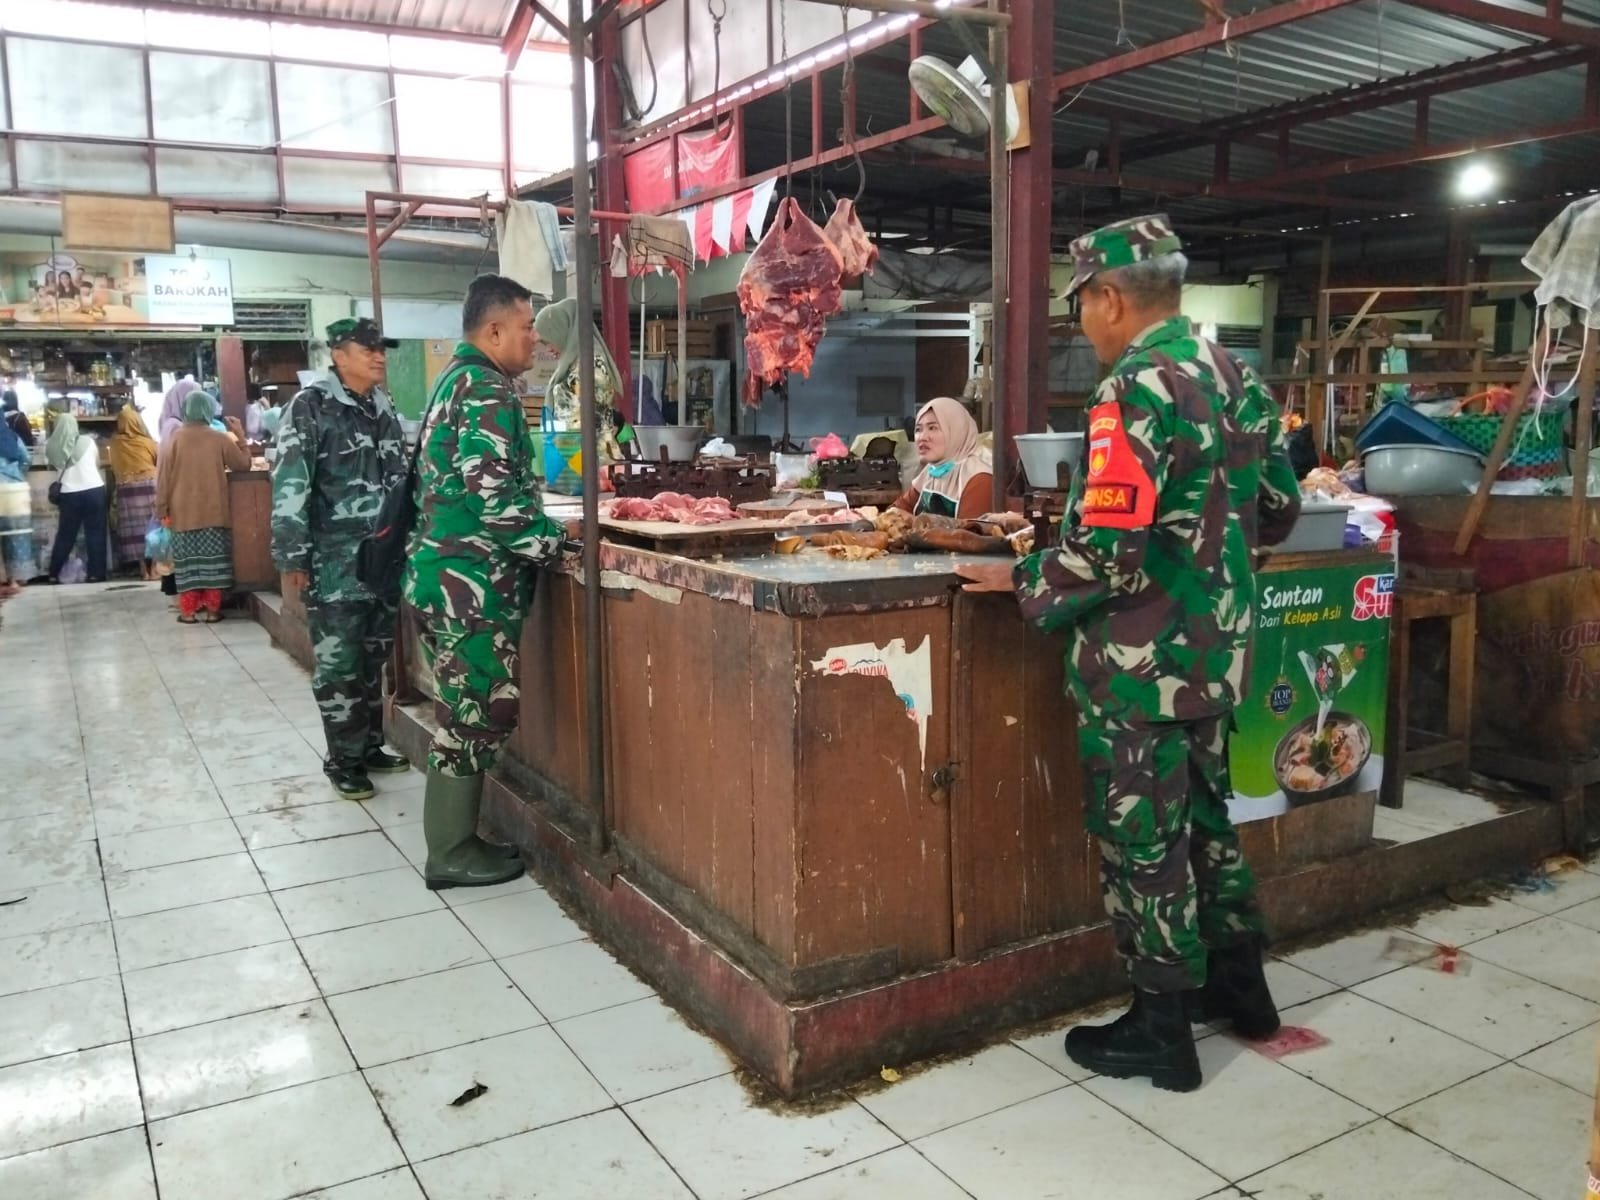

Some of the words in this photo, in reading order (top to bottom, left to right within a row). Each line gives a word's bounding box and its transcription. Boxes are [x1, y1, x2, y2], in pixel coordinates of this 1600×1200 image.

[153, 284, 229, 297] BAROKAH
[1260, 584, 1324, 610] Santan
[1259, 614, 1281, 629] Dari
[1283, 609, 1319, 628] Kelapa
[1322, 605, 1343, 621] Asli
